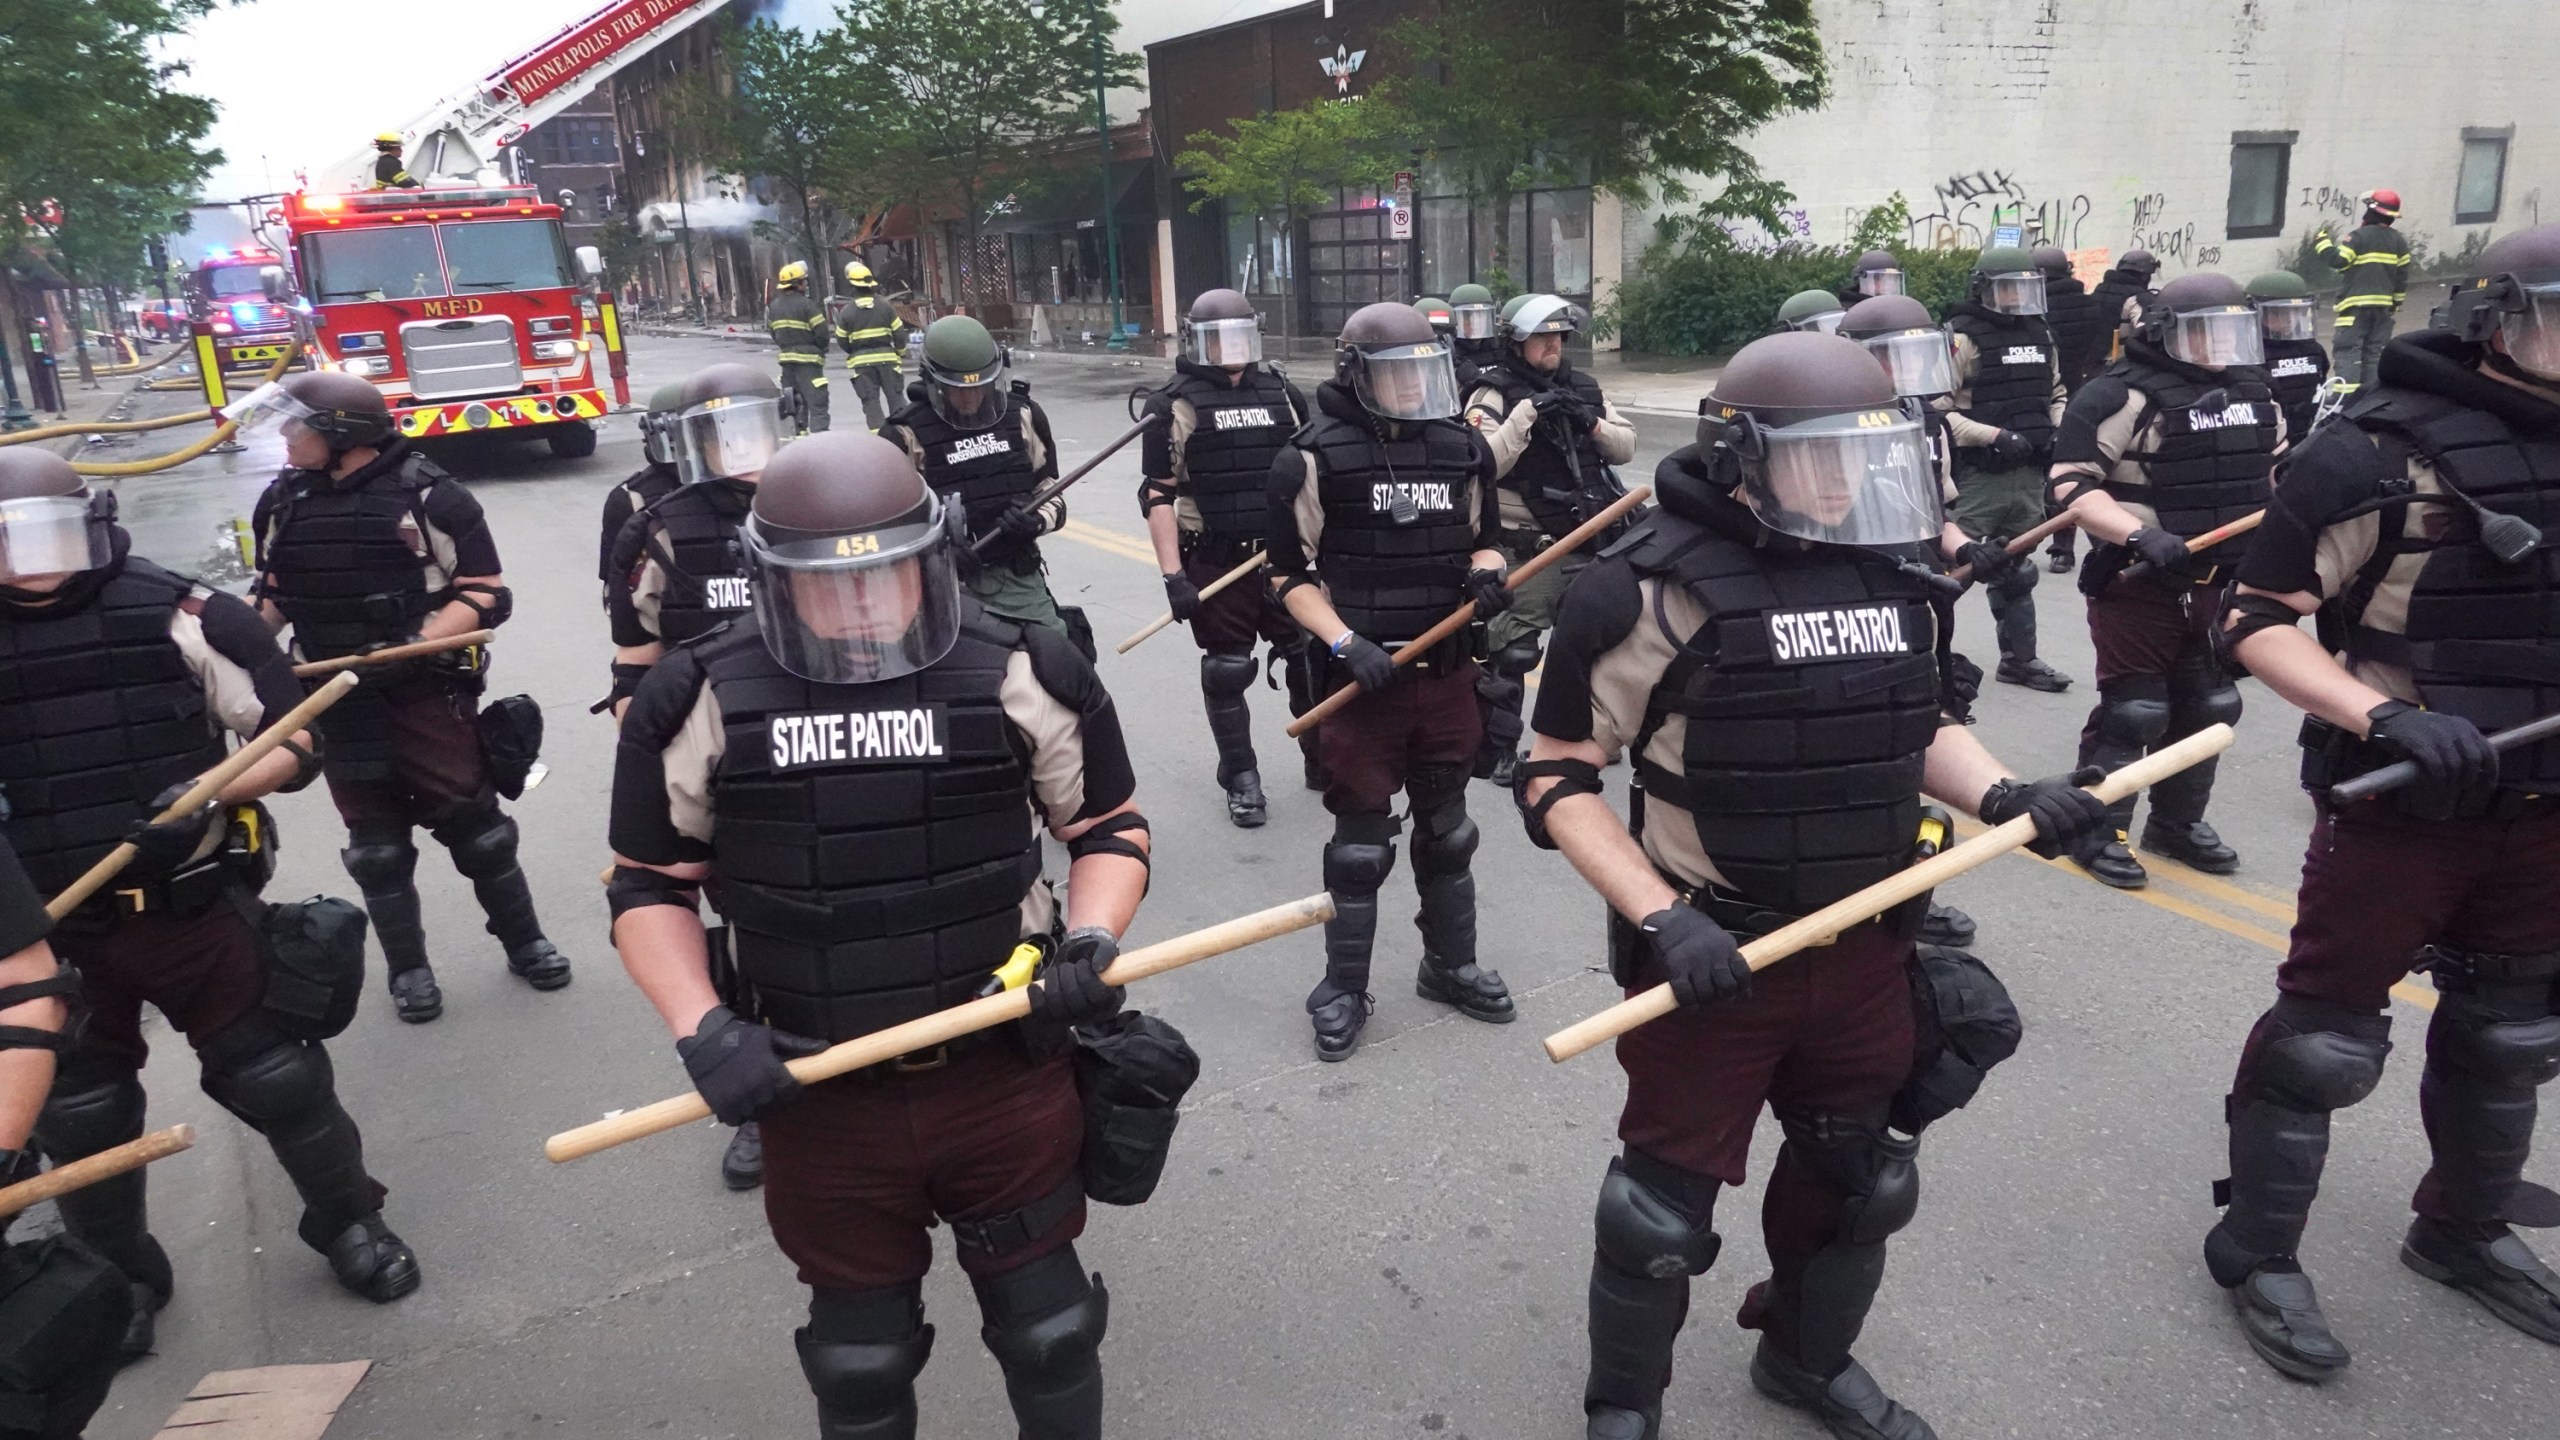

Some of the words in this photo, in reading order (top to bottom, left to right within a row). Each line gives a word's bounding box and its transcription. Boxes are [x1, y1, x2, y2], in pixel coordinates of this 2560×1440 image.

[514, 29, 612, 97] MINNEAPOLIS
[611, 9, 647, 38] FIRE
[2008, 345, 2038, 356] POLICE
[2278, 357, 2309, 369] POLICE
[964, 374, 980, 384] 397
[440, 412, 454, 428] L
[497, 405, 522, 421] 11
[1215, 409, 1242, 430] STATE
[1241, 408, 1275, 427] PATROL
[1857, 412, 1891, 427] 449
[2222, 402, 2258, 427] PATROL
[946, 445, 988, 465] CONSERVATION
[986, 440, 1011, 455] OFFICER
[955, 433, 997, 452] POLICE
[1411, 482, 1453, 510] PATROL
[836, 534, 880, 556] 454
[706, 577, 752, 609] STATE
[1771, 611, 1838, 660] STATE
[1833, 606, 1908, 654] PATROL
[772, 714, 846, 768] STATE
[850, 708, 943, 759] PATROL
